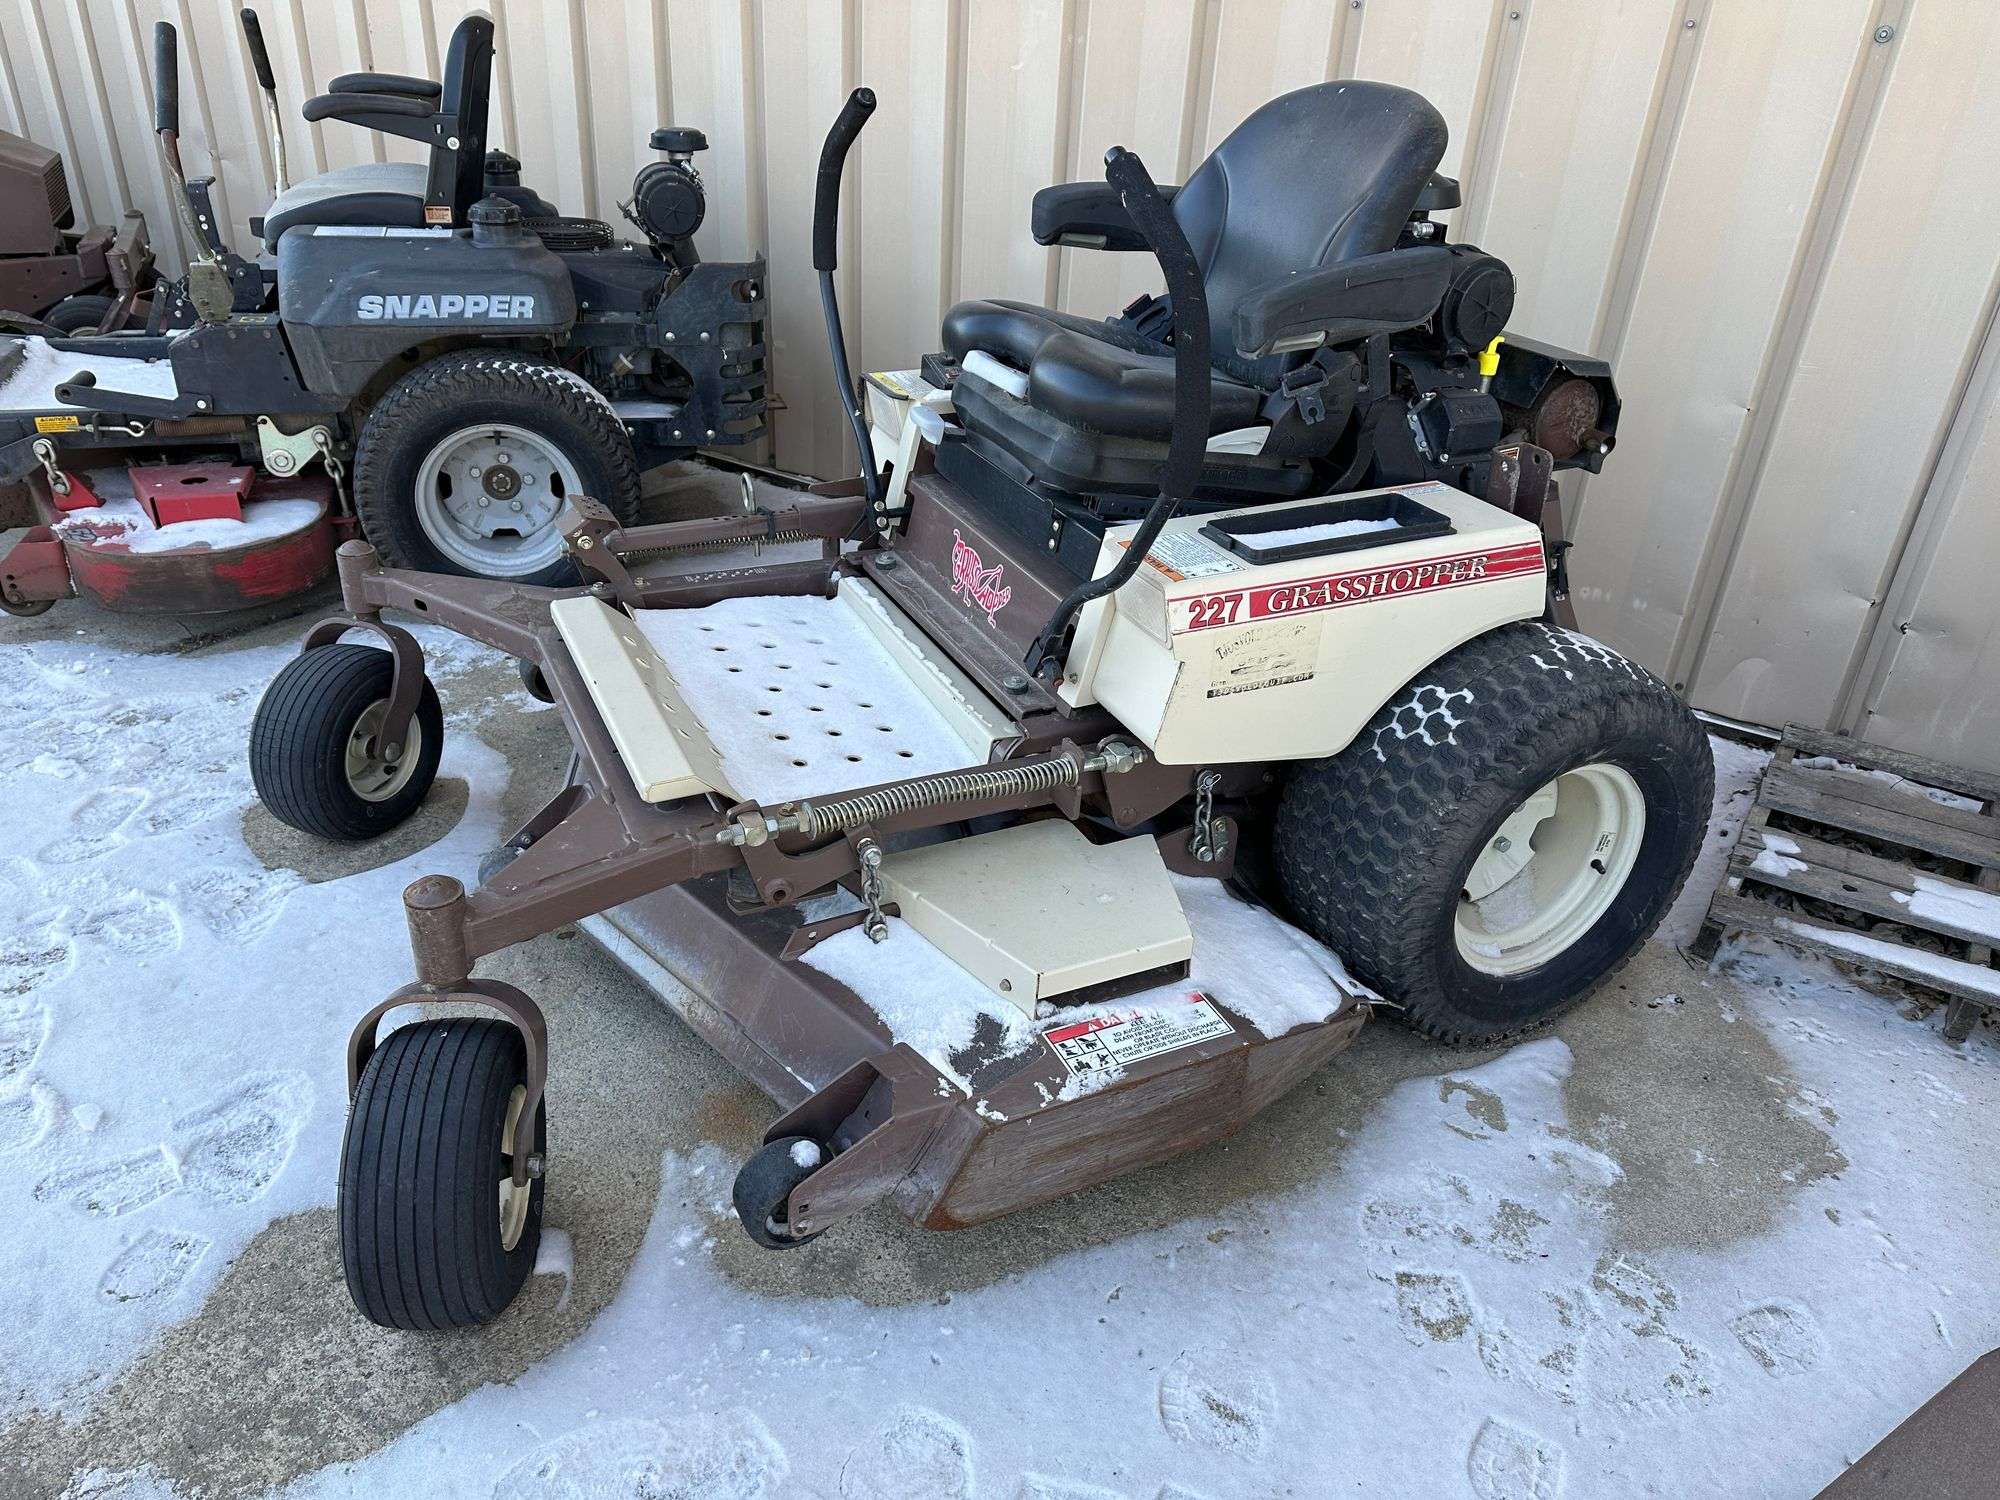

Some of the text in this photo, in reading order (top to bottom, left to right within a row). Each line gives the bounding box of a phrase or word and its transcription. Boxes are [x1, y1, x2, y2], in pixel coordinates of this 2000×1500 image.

[357, 294, 535, 320] SNAPPER
[1188, 555, 1489, 630] 227 GRASSHOPPER
[1113, 1045, 1133, 1056] NEVER
[1134, 1038, 1160, 1050] OPERATE
[1161, 1029, 1187, 1041] WITHOUT
[1187, 1020, 1222, 1033] DISCHARGE
[1122, 1048, 1143, 1058] CHUTE
[1143, 1044, 1153, 1053] OR
[1167, 1034, 1192, 1046] SHIELDS
